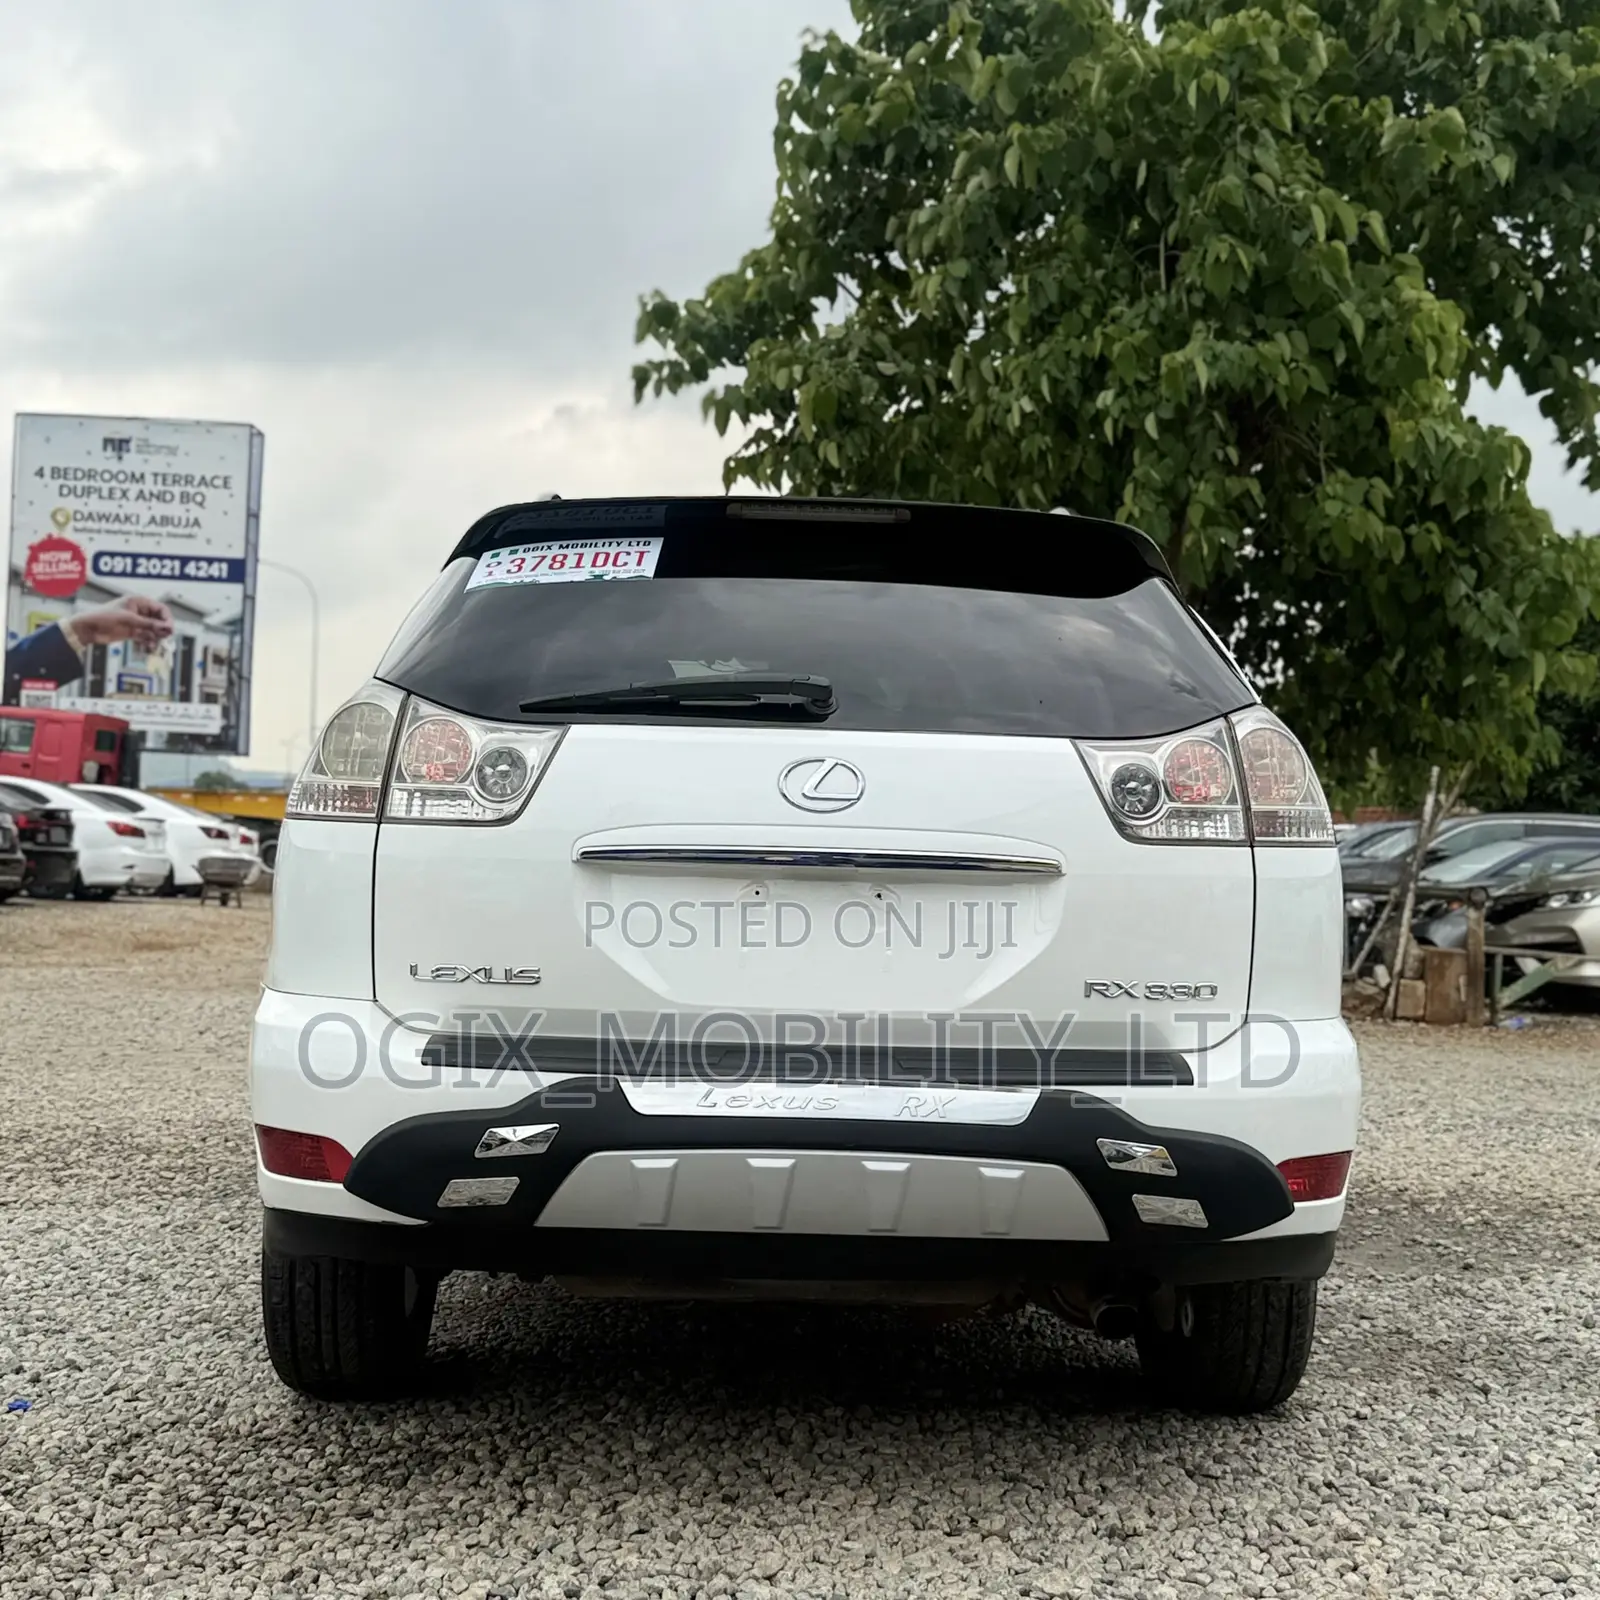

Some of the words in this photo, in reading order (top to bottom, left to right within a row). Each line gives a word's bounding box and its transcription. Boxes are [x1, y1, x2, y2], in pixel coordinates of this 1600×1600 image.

[34, 466, 45, 480] 4
[50, 467, 146, 485] BEDROOM
[151, 472, 233, 490] TERRACE
[59, 484, 130, 501] DUPLEX
[134, 488, 174, 504] AND
[179, 491, 207, 509] BQ
[73, 510, 140, 525] DAWAKI
[558, 540, 623, 550] MOBILITY
[99, 555, 132, 573] 091
[135, 558, 180, 576] 2021
[184, 561, 229, 579] 4241
[409, 961, 542, 985] LEXUS
[1144, 980, 1219, 1001] 330
[696, 1087, 841, 1112] Lexus
[895, 1095, 957, 1119] RX
